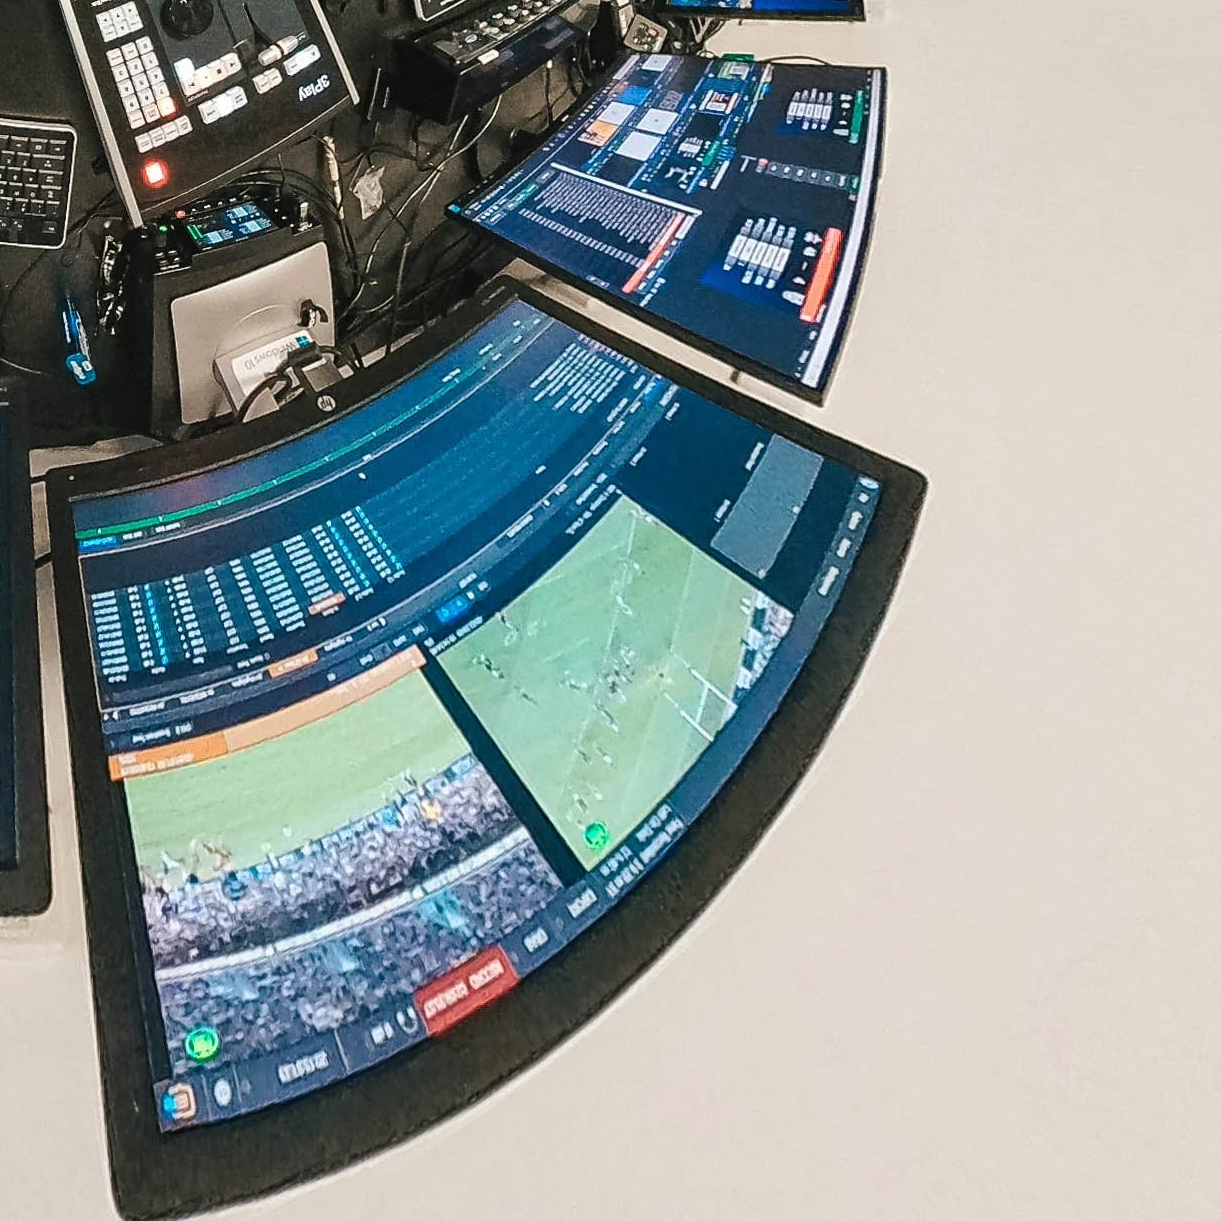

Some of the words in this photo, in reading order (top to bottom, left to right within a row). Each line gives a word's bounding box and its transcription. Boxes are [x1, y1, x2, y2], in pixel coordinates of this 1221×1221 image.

[299, 75, 330, 102] 3Play
[244, 355, 256, 370] 10
[254, 341, 295, 364] Windows
